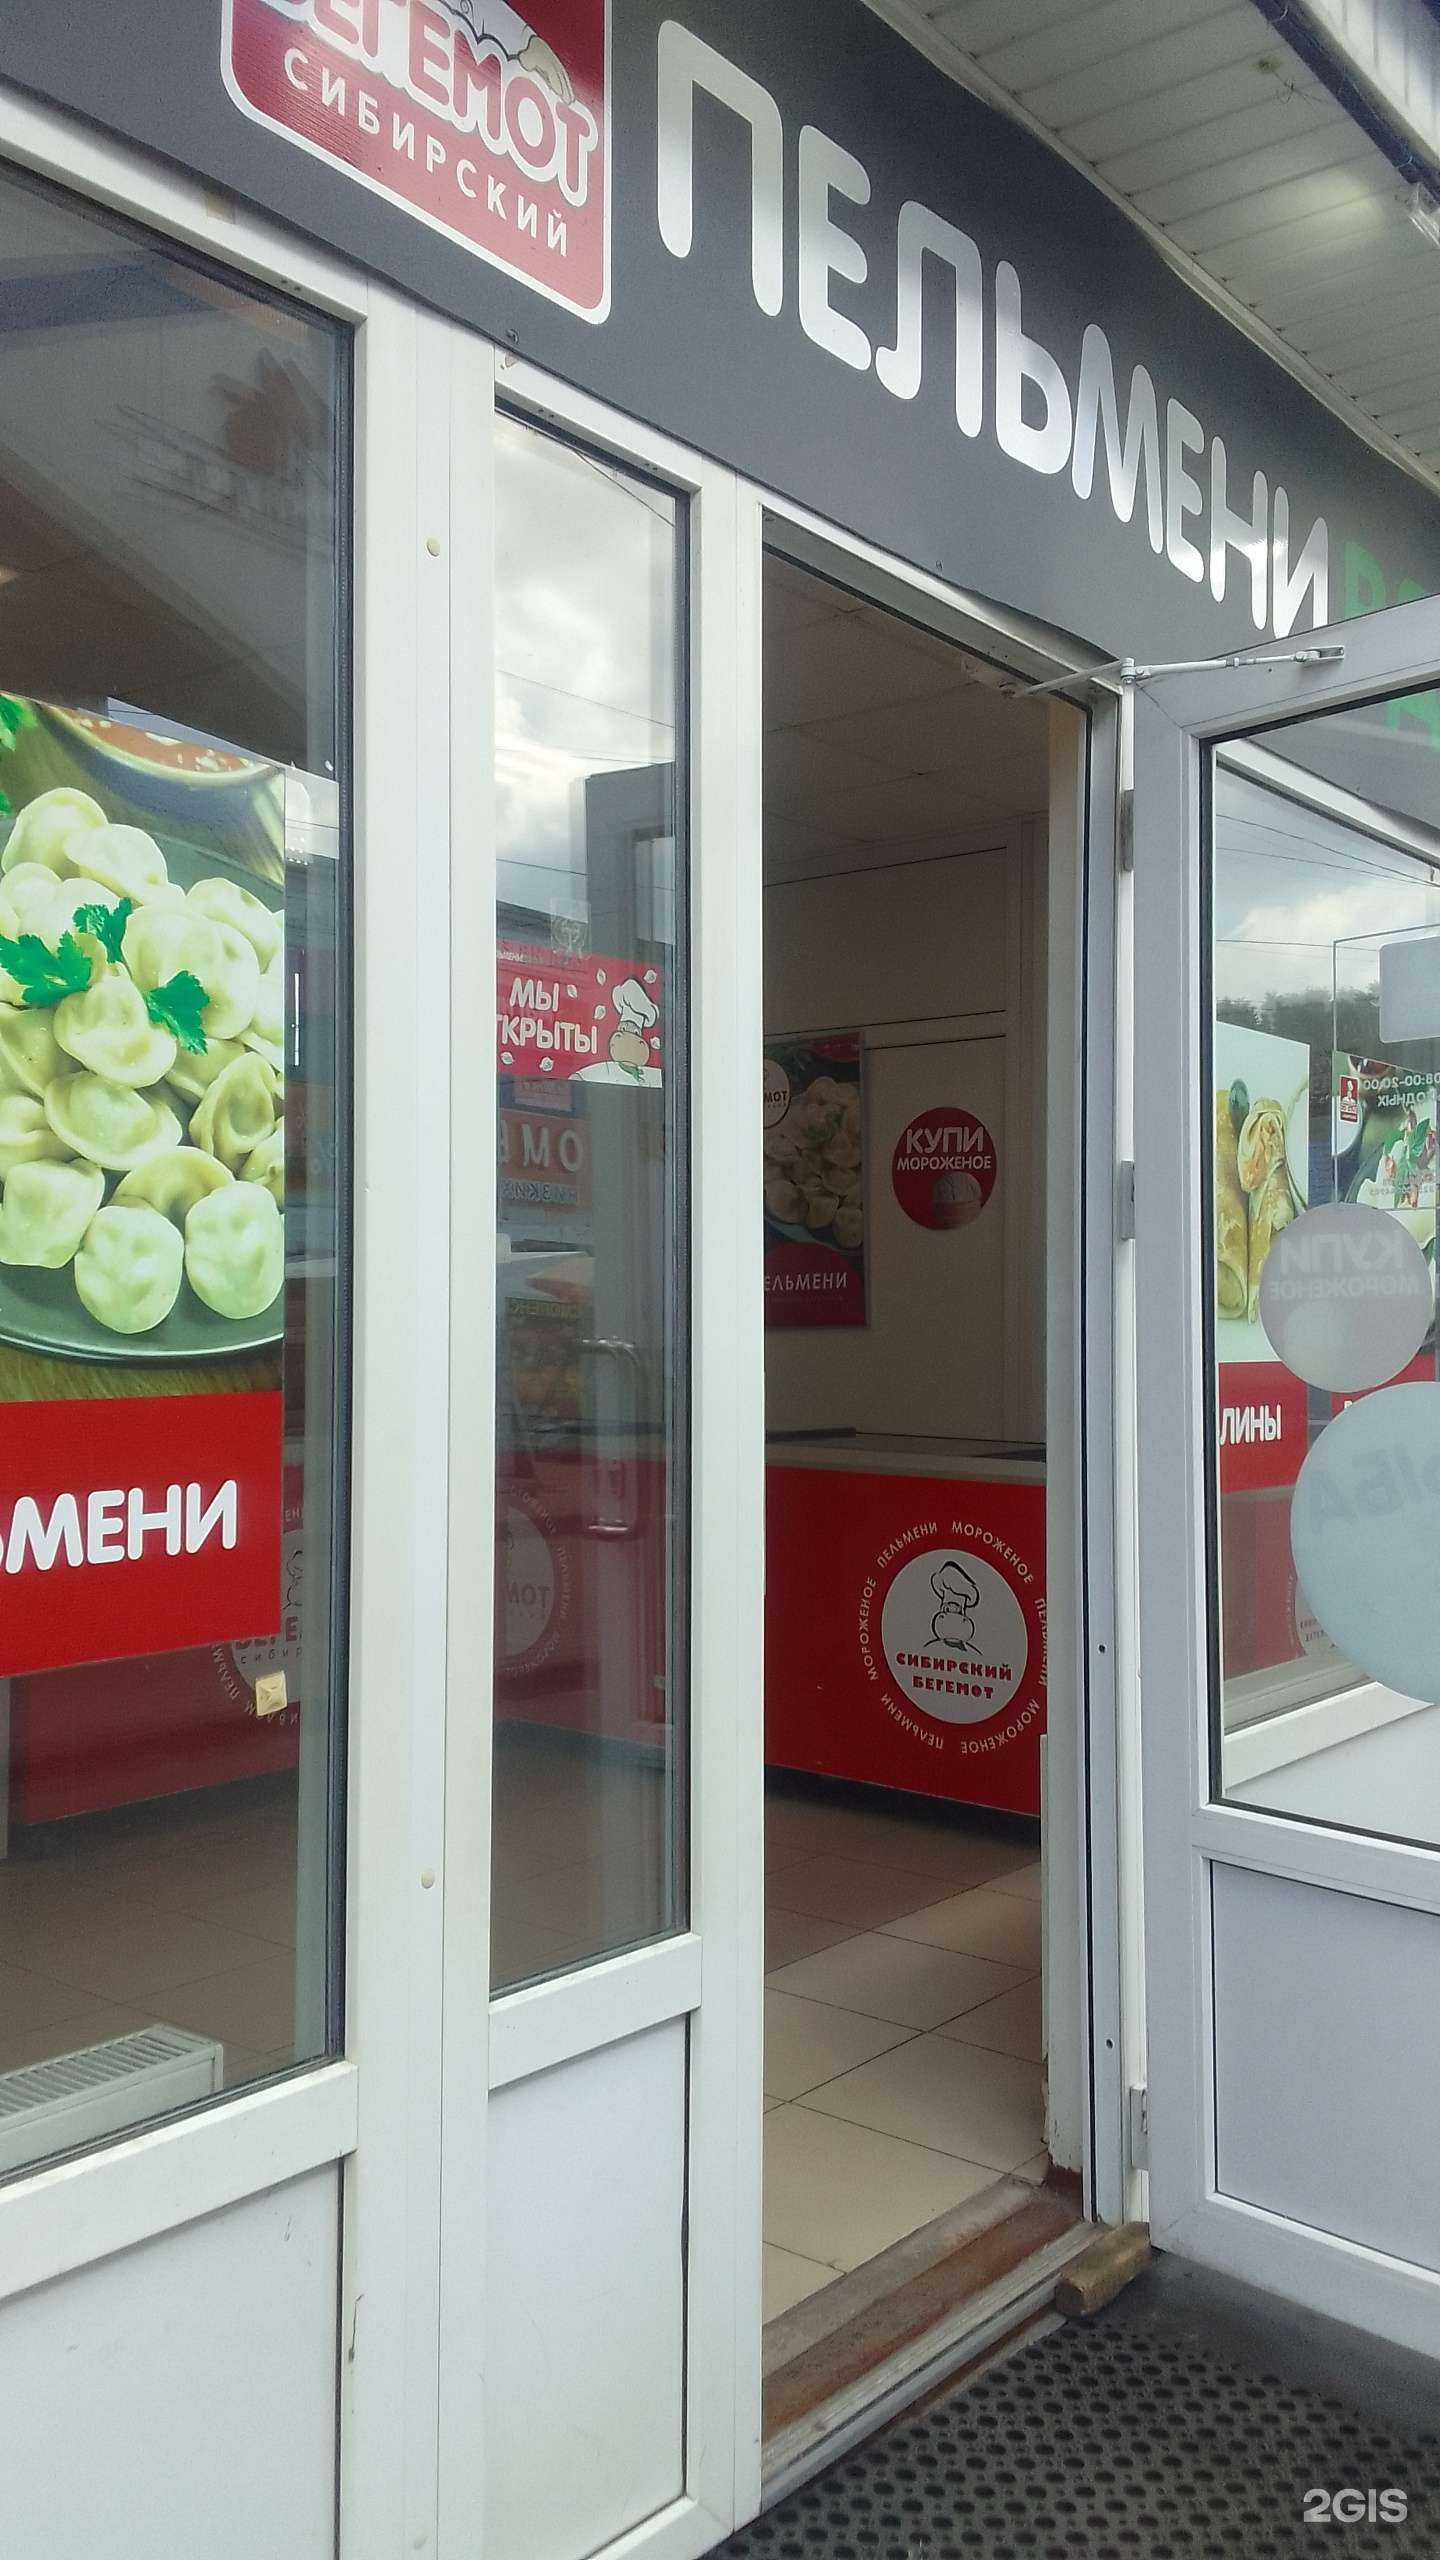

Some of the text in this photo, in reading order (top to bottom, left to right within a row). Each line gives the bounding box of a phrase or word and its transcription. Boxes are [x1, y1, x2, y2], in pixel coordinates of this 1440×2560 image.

[284, 47, 569, 257] СИБИРСКИЙ
[657, 19, 1329, 641] ПЕЛЬМЕНИ
[509, 976, 560, 1012] МЫ
[897, 1155, 992, 1171] МОРОЖЕНОЕ
[906, 1126, 984, 1154] КУПИ
[1219, 1403, 1282, 1446] ЛИНЫ
[0, 1479, 237, 1575] МЕНИ
[876, 1521, 938, 1569] ПЕЛЬМЕНИ
[951, 1520, 1034, 1585] МОРОЖЕНОЕ
[857, 1576, 879, 1682] МОРОЖЕНОЕ
[896, 1652, 1013, 1681] СИБИРСКИЙ
[912, 1675, 995, 1699] БЕГЕМОТ
[880, 1693, 944, 1750] ПЕЛЬМЕНИ
[960, 1698, 1041, 1755] МОРОЖЕНОЕ
